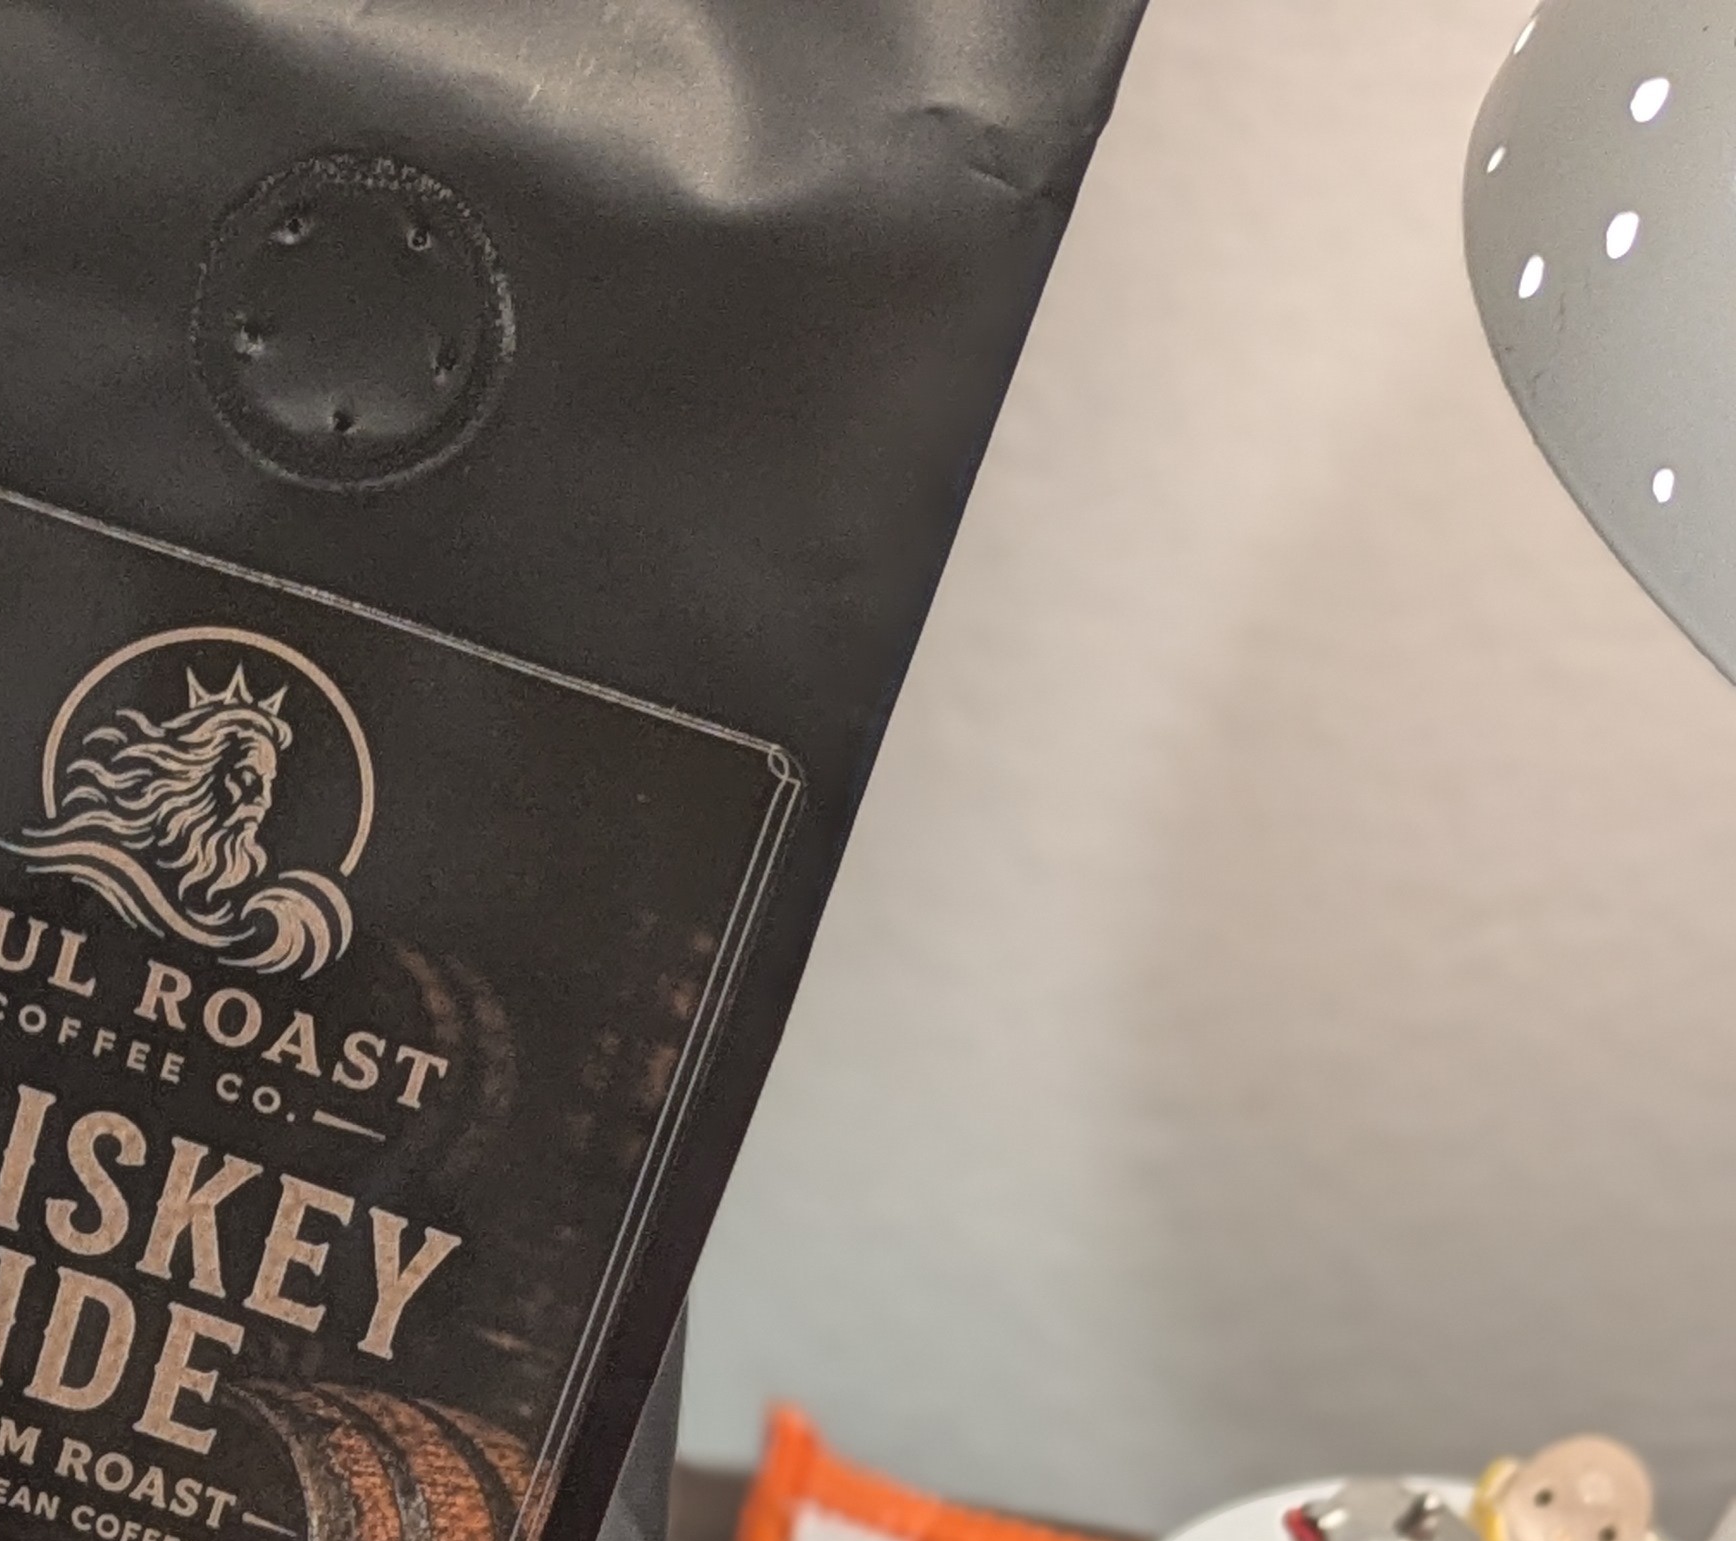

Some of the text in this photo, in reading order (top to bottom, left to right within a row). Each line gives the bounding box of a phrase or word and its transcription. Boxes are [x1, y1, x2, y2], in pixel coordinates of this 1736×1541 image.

[132, 958, 449, 1110] ROAST
[215, 1072, 298, 1125] CO.
[54, 1438, 238, 1532] ROAST
